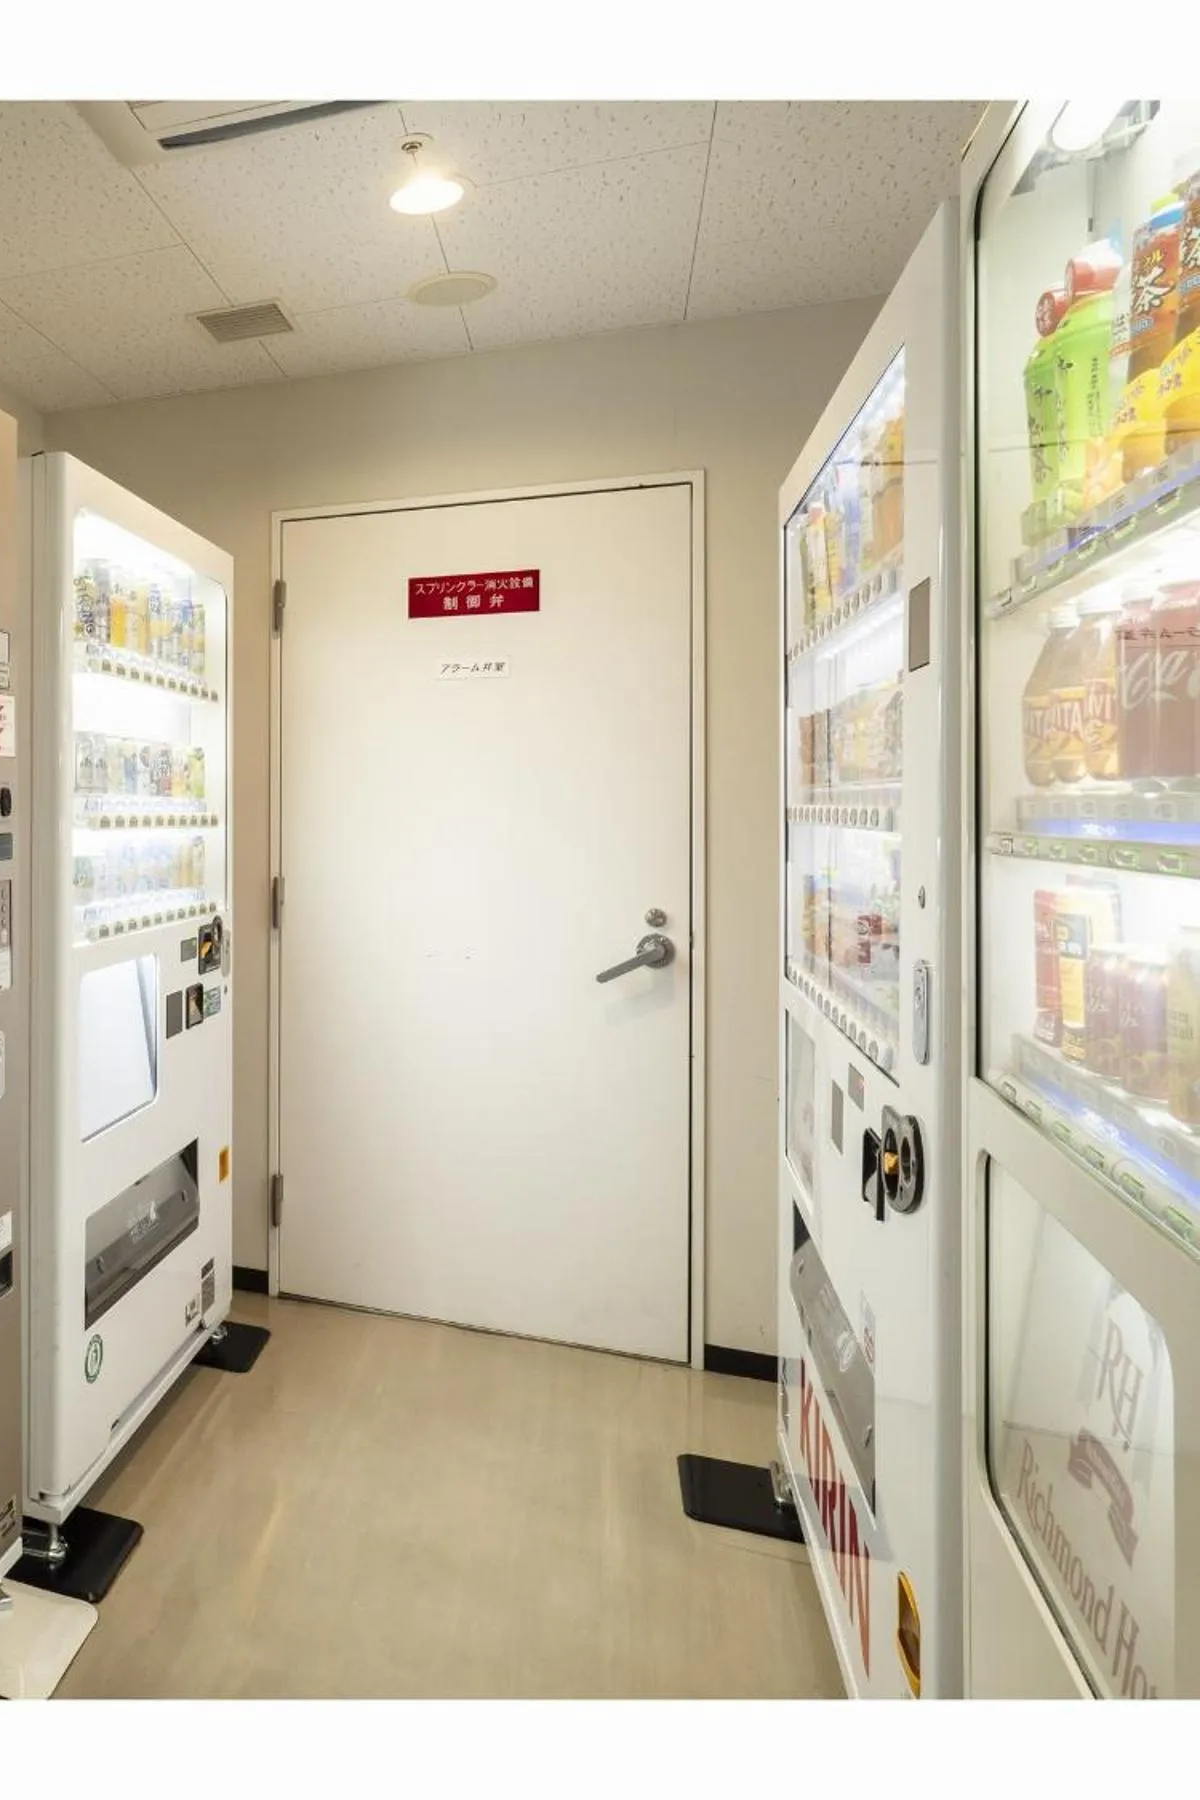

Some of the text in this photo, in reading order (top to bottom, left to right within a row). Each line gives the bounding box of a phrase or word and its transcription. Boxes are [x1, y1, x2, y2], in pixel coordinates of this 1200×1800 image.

[415, 576, 534, 596] スプリンクラー消火設備
[442, 593, 505, 611] 制御弁
[1097, 1317, 1144, 1445] RH
[801, 1358, 870, 1679] KIRIN
[1016, 1438, 1158, 1699] Richmond Ho
